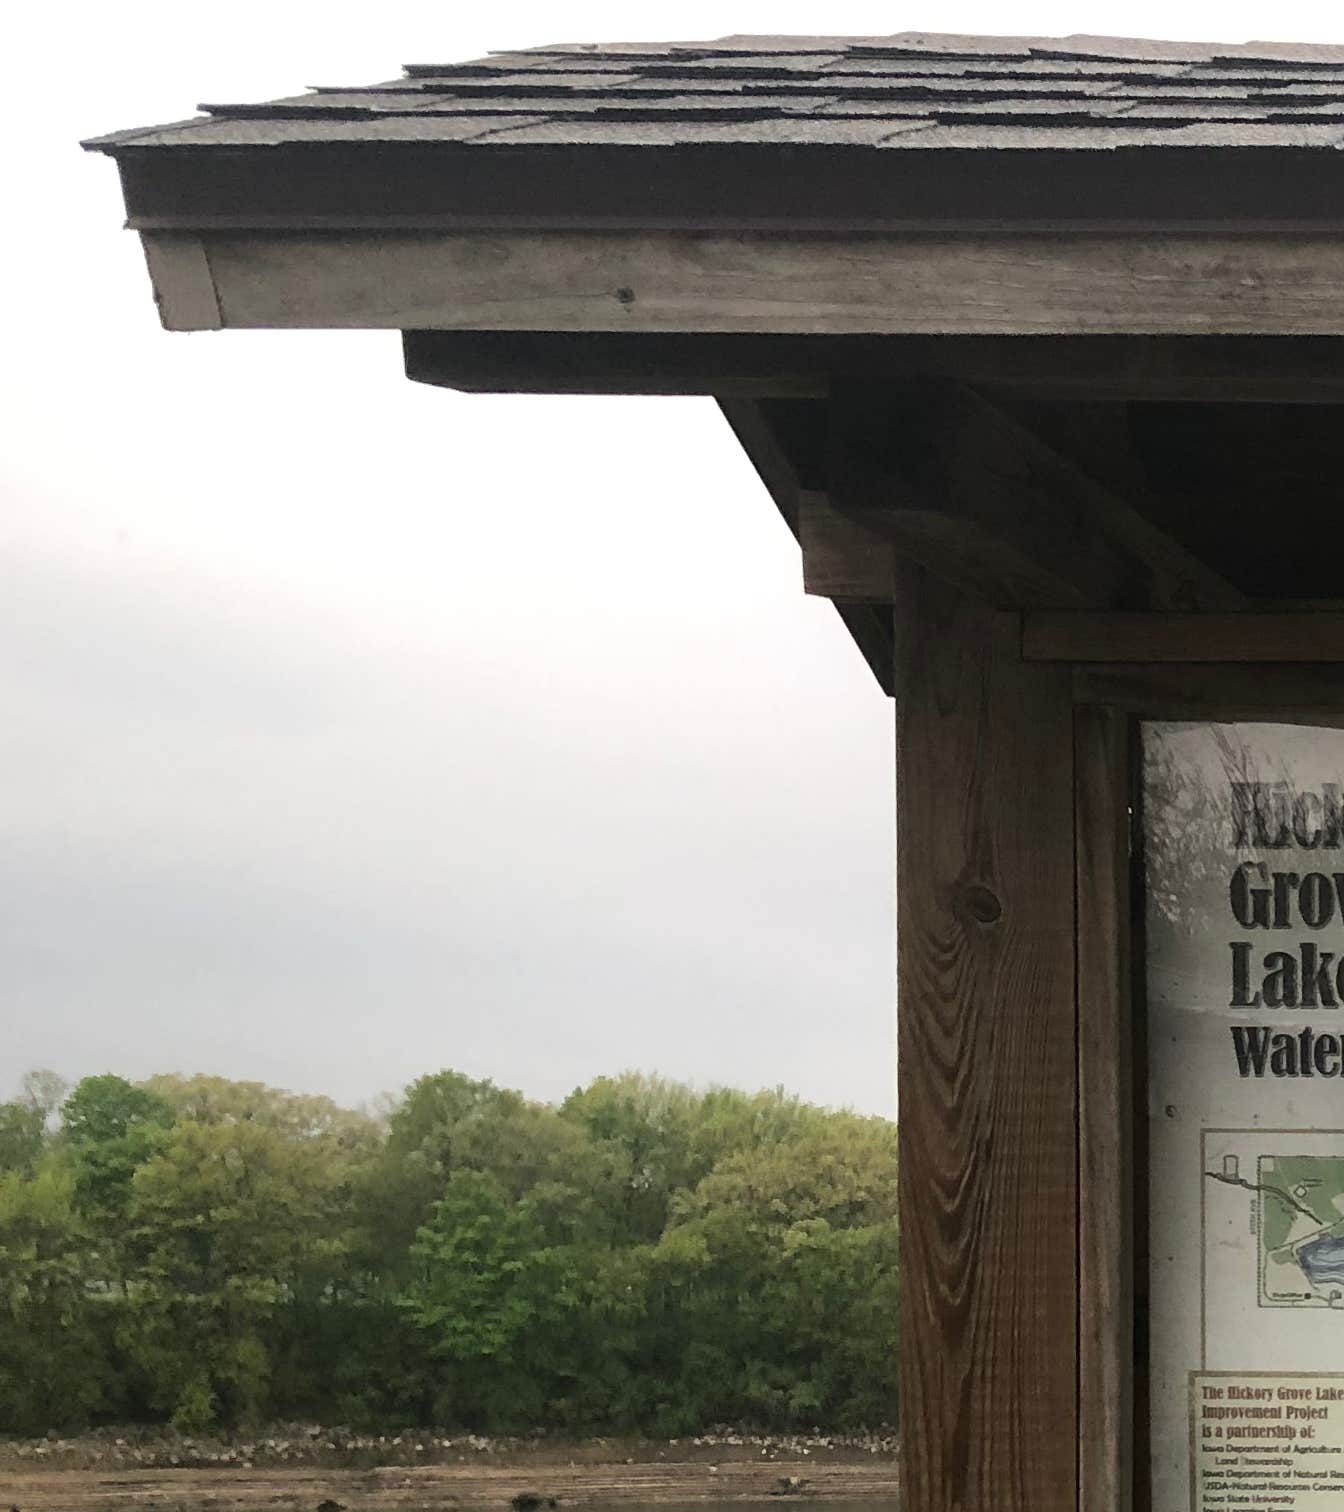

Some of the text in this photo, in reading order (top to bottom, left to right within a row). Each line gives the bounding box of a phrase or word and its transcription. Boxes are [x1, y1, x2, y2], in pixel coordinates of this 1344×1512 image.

[1202, 1405, 1328, 1420] Improvement Project
[1202, 1424, 1316, 1440] is a partnership of:
